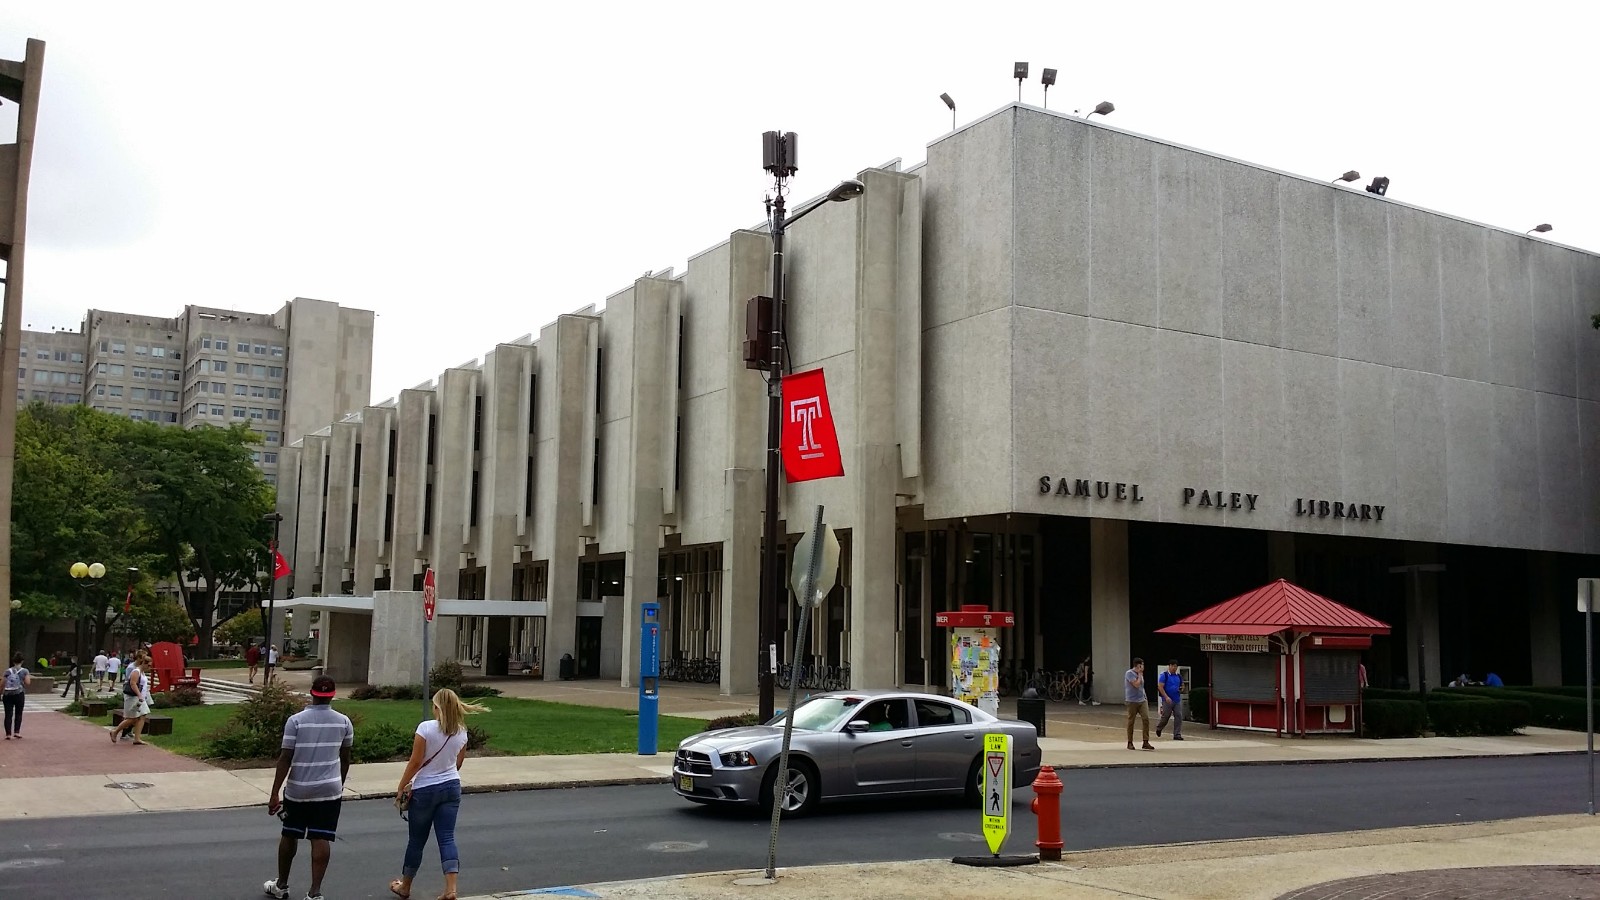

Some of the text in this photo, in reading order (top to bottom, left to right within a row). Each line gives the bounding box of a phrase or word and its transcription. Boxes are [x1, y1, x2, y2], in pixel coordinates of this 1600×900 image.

[1039, 475, 1386, 521] SAMUEL PALEY LIBRARY
[425, 584, 435, 605] STOP
